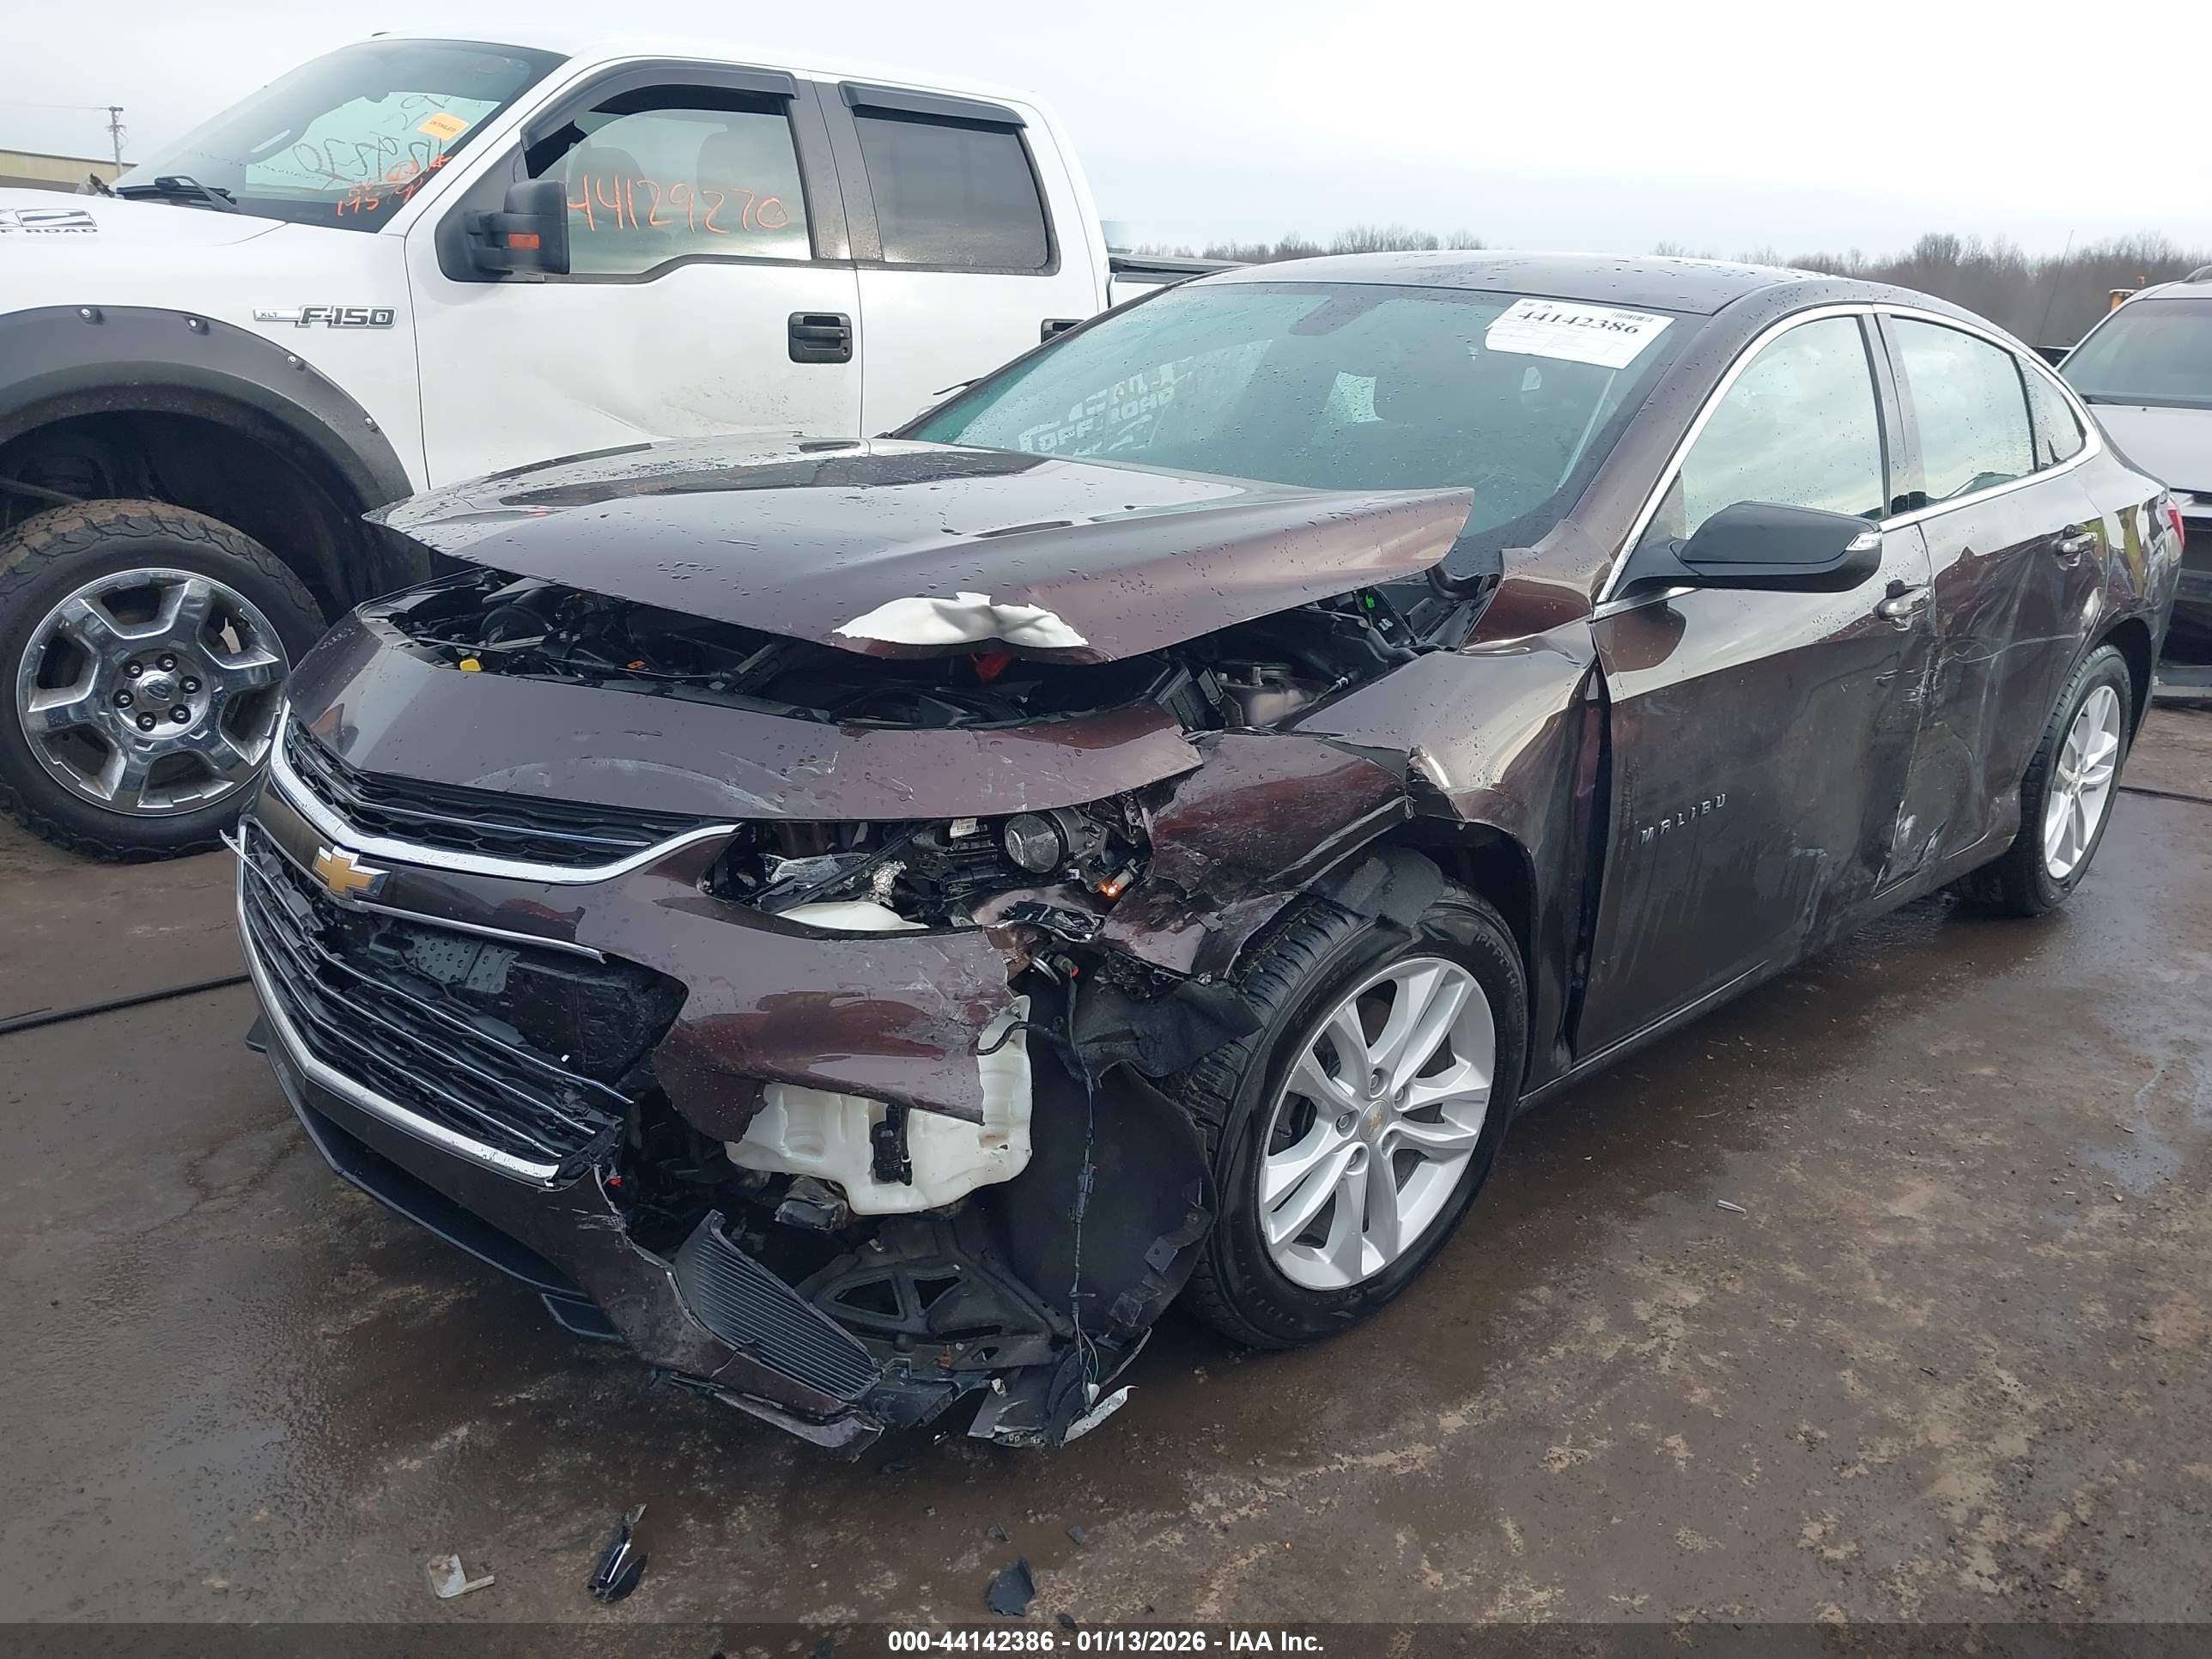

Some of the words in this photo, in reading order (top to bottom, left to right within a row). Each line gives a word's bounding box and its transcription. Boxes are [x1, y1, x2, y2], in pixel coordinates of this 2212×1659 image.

[567, 174, 790, 234] 44129270
[301, 307, 396, 325] F-150
[1517, 310, 1642, 334] 44142386
[1638, 793, 1727, 845] MALIBU
